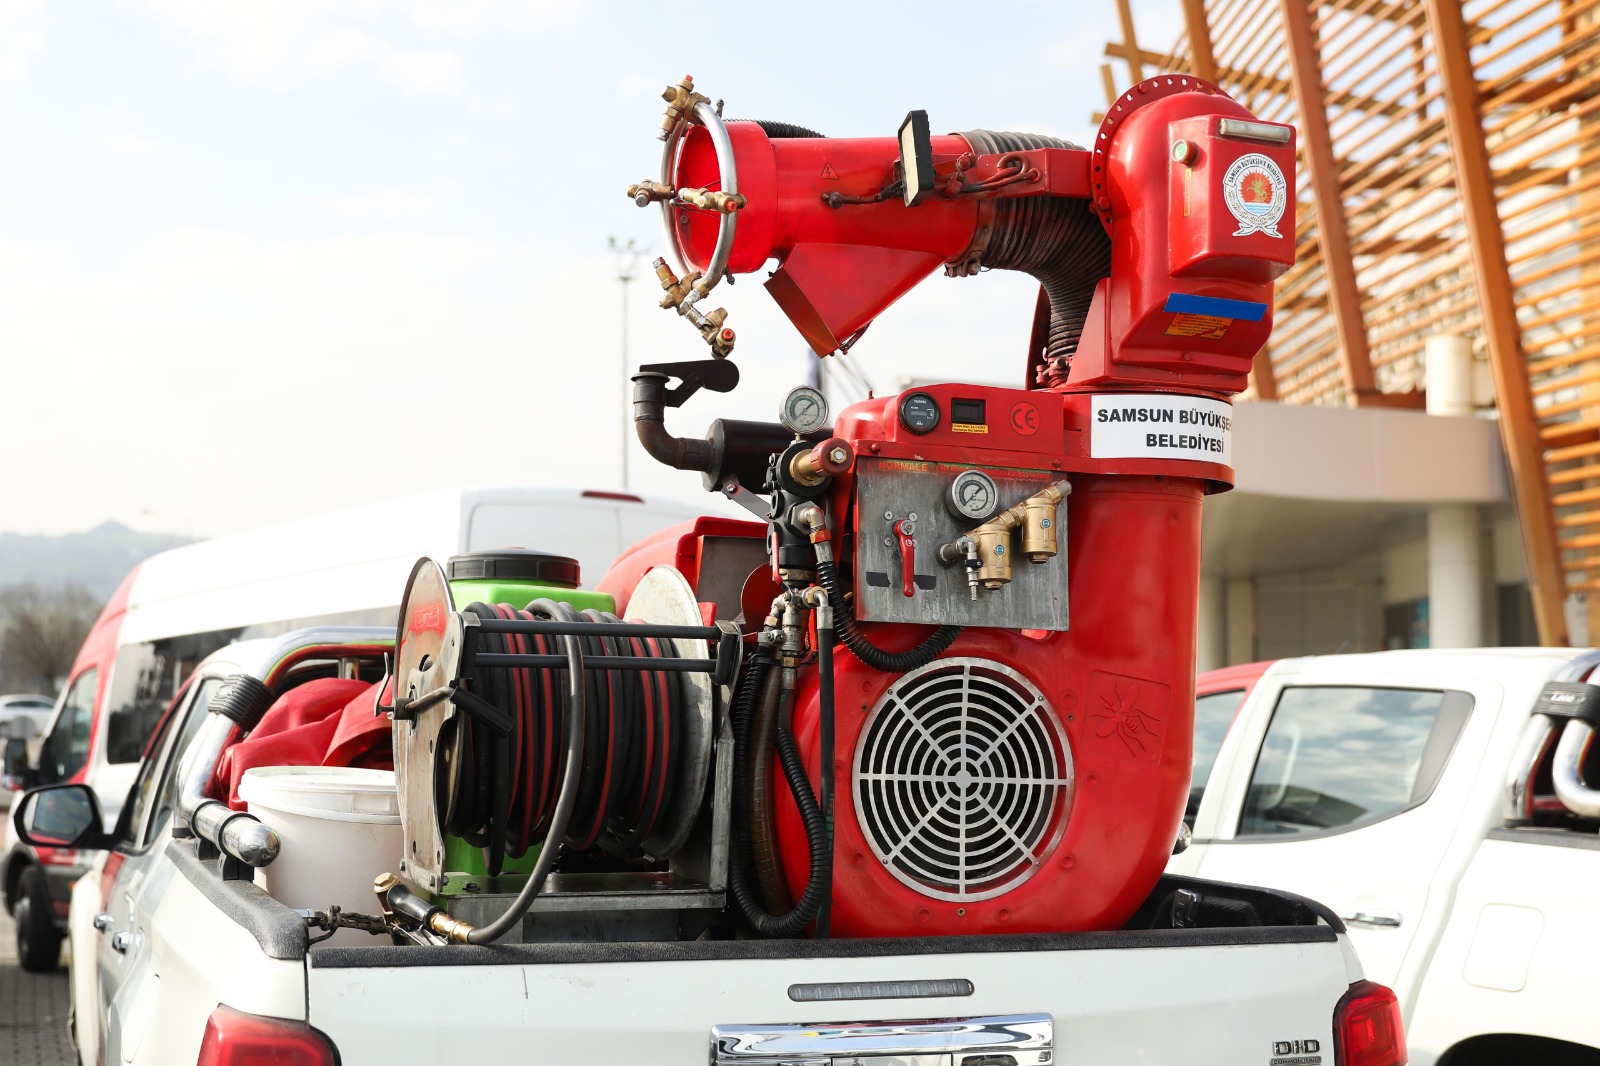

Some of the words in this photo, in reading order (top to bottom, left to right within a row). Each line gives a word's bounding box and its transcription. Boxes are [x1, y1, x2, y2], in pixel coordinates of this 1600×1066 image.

[1097, 408, 1174, 423] SAMSUN
[1146, 433, 1224, 454] BELEDİYESİ
[878, 461, 928, 472] NORMALE
